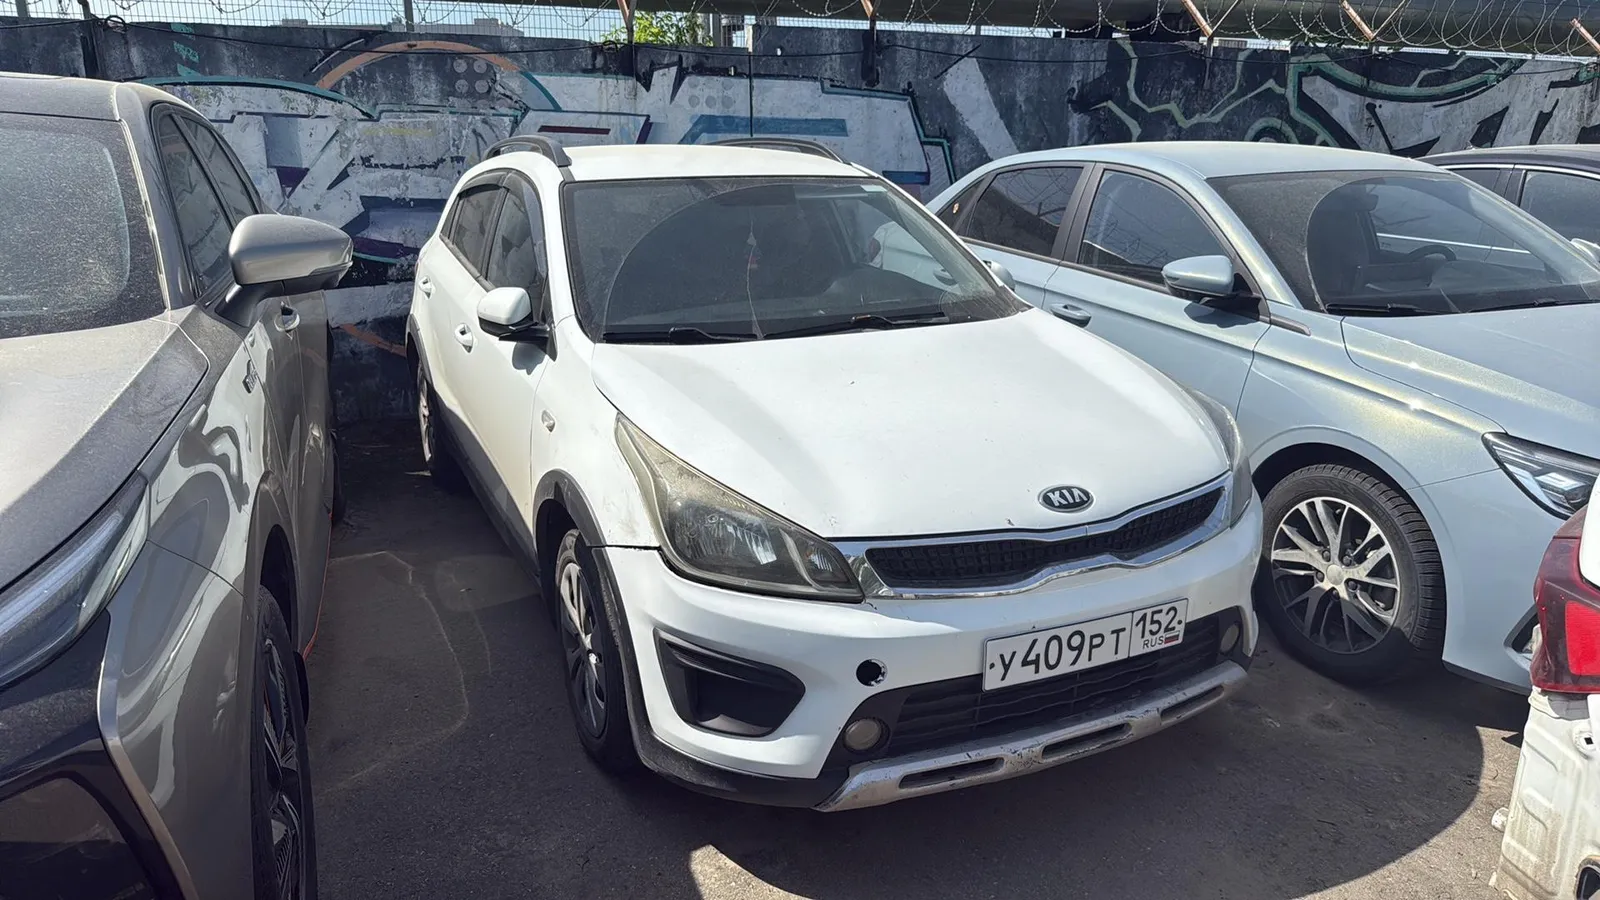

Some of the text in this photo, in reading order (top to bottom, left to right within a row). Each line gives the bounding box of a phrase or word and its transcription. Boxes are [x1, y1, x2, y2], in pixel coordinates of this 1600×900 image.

[1046, 487, 1089, 507] KIA
[1135, 605, 1178, 640] 152
[1142, 635, 1164, 650] RUS
